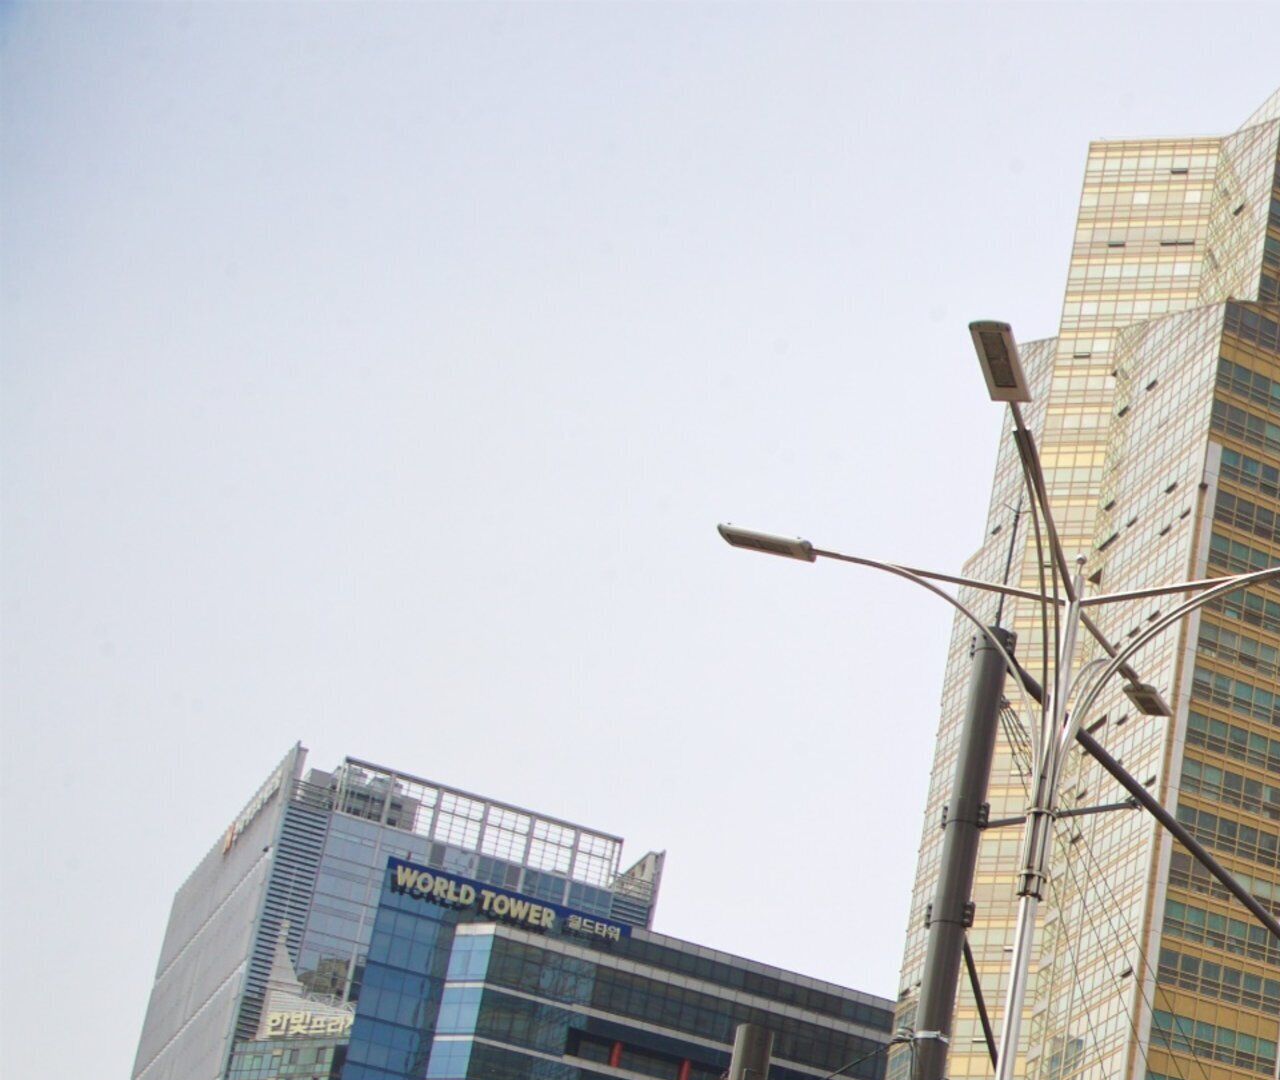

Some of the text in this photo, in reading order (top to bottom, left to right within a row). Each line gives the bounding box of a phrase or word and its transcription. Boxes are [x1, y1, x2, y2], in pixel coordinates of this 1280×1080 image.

[396, 864, 556, 929] WORLD TOWER
[567, 913, 621, 943] 월드타워
[266, 1010, 354, 1035] 한빛프라
